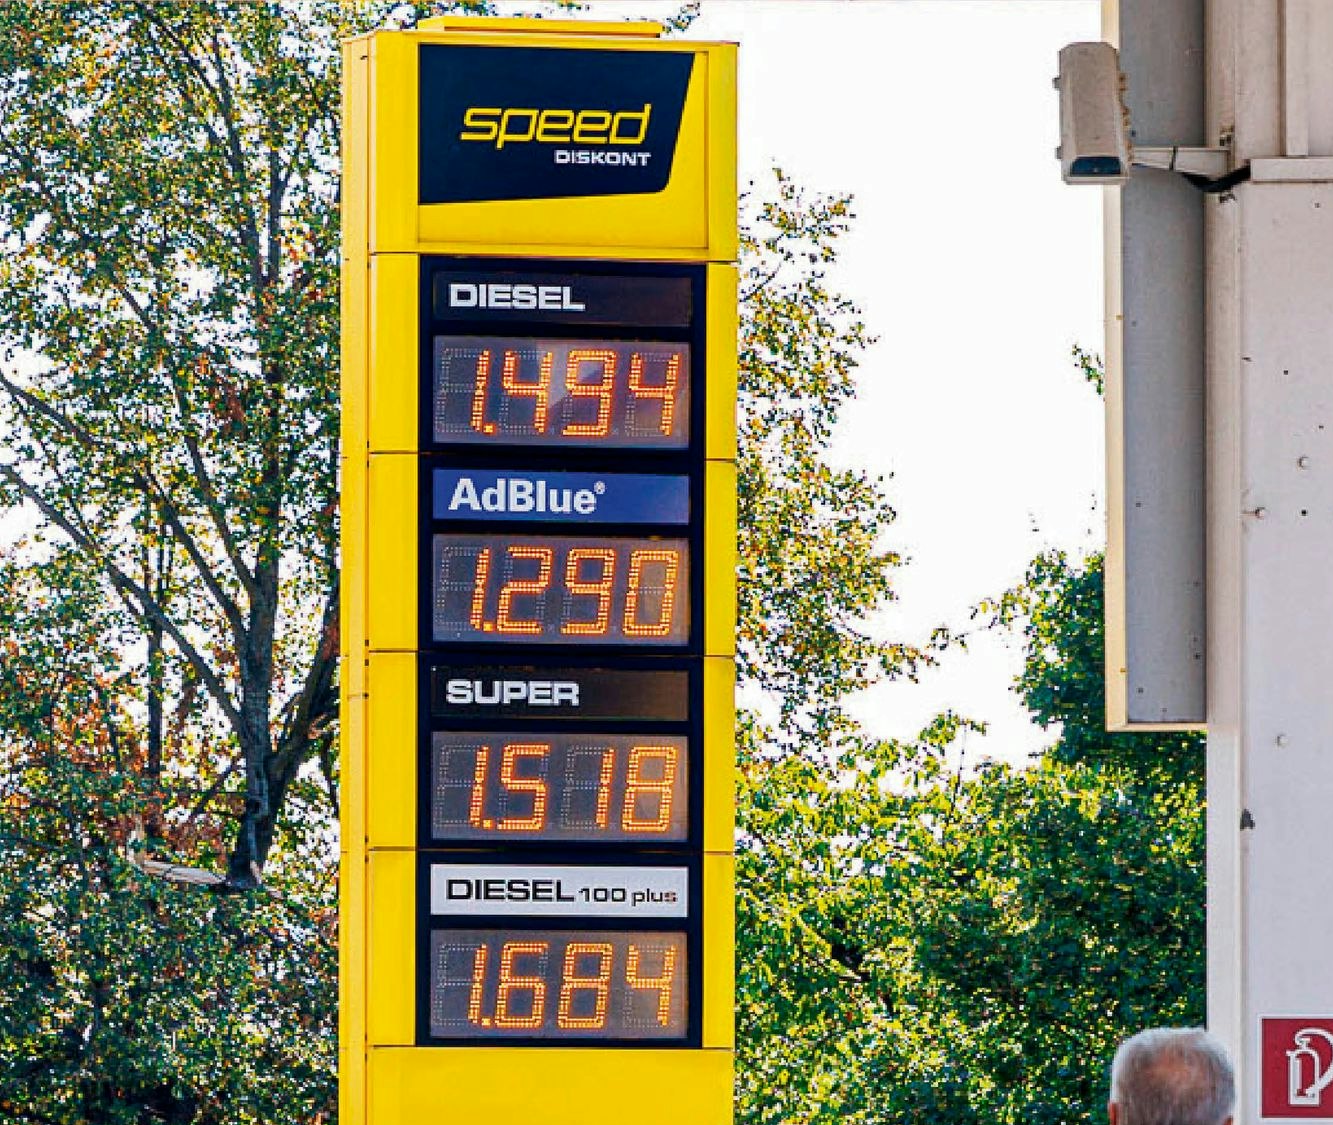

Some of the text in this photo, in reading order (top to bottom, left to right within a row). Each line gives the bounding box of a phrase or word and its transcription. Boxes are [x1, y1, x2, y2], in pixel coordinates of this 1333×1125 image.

[459, 103, 653, 151] speed
[554, 149, 652, 167] DISKONT
[449, 283, 586, 312] DIESEL
[470, 349, 680, 437] 1.494
[471, 546, 679, 636] 1.290
[445, 679, 580, 707] SUPER
[468, 743, 678, 832] 1.518
[445, 877, 679, 908] DIESEL 100 plus
[467, 942, 677, 1030] 1.684
